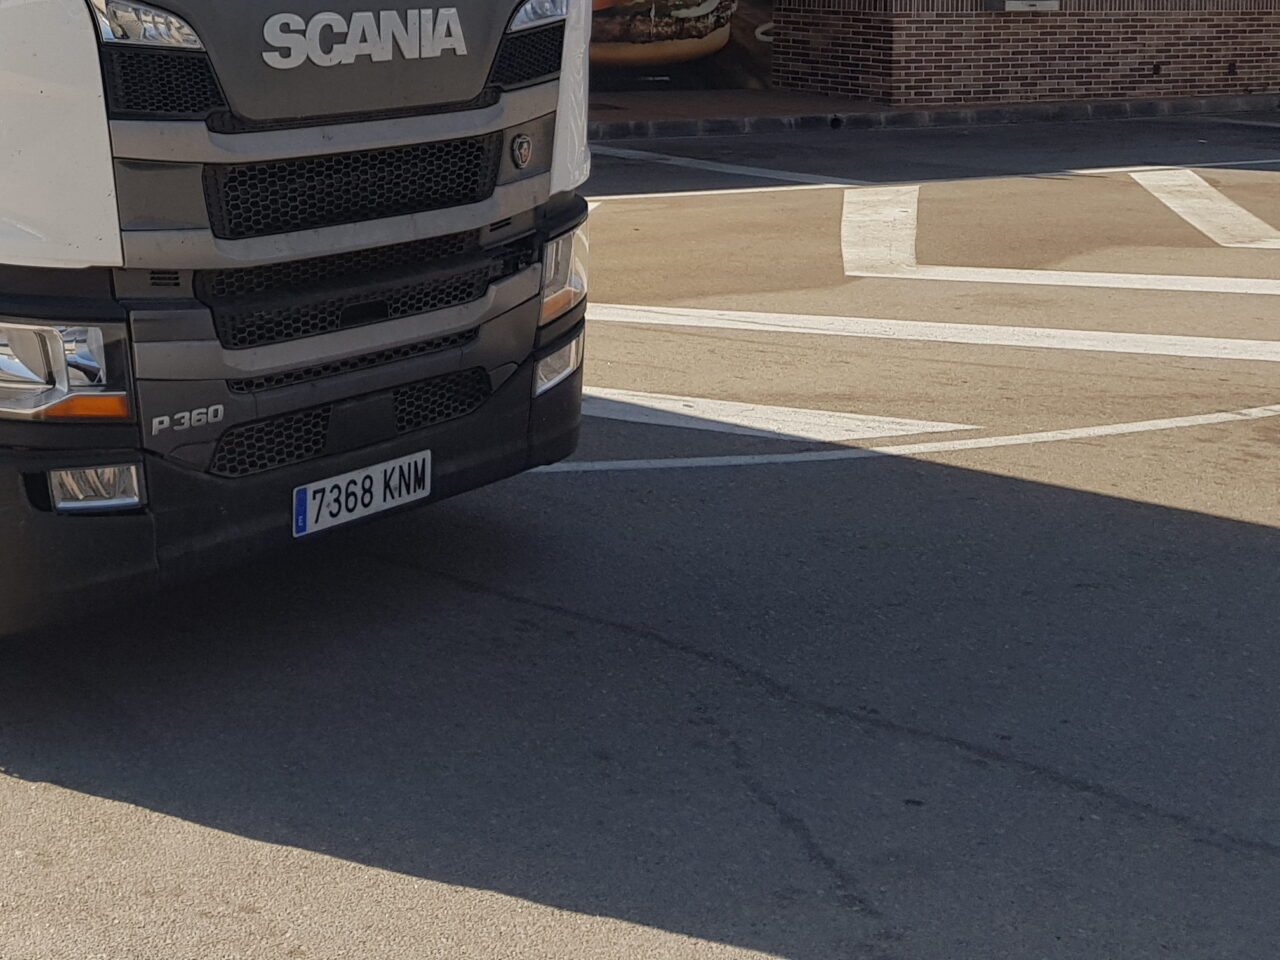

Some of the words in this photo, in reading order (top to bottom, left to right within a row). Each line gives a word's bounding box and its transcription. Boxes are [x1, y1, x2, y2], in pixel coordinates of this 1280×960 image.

[261, 6, 468, 71] SCANIA
[312, 474, 374, 525] 7368
[382, 456, 426, 503] KNM
